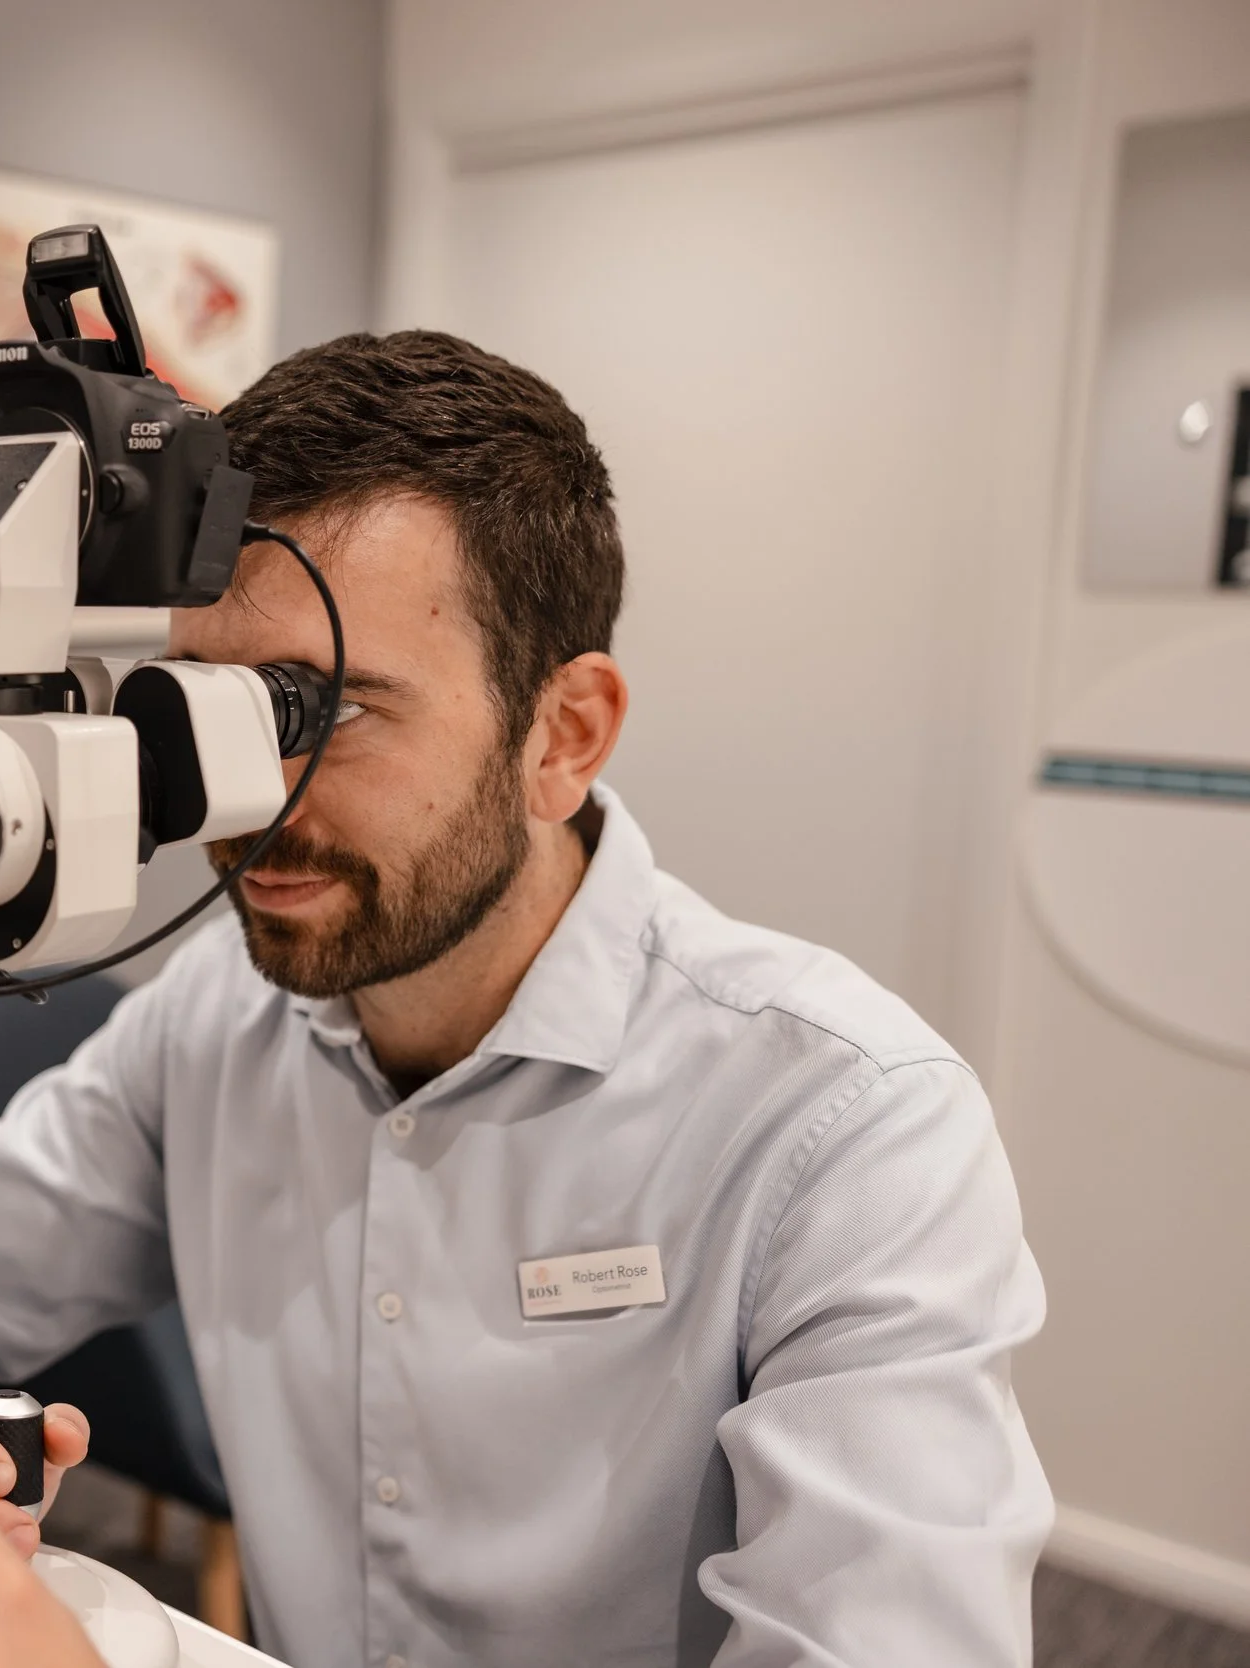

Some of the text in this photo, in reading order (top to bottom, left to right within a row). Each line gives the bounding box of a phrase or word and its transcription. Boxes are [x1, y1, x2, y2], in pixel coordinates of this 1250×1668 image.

[131, 422, 160, 436] EOS
[127, 437, 162, 449] 1300D
[572, 1265, 648, 1283] Robert Rose
[527, 1284, 562, 1299] ROSE
